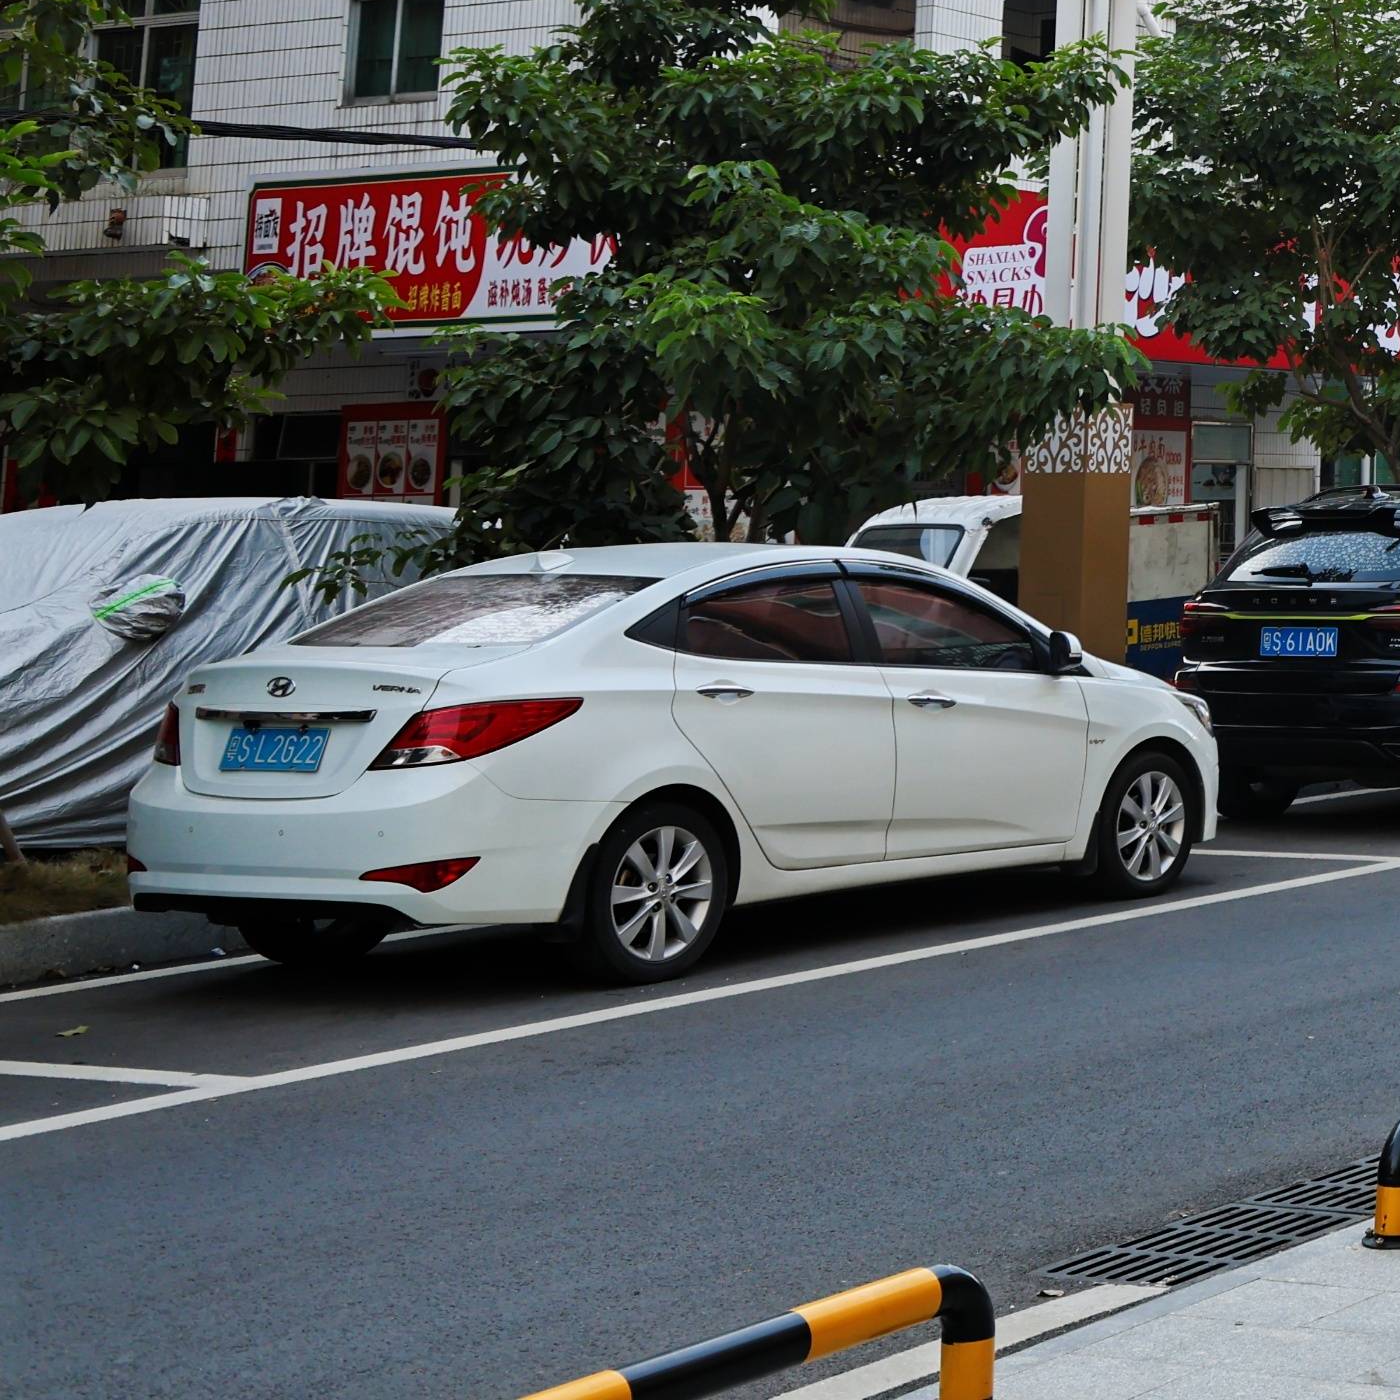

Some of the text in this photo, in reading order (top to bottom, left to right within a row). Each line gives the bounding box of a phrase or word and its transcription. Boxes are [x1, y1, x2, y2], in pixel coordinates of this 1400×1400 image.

[286, 189, 476, 281] 招牌馄饨
[967, 250, 1026, 267] SHAXIAN
[966, 265, 1032, 286] SNACKS
[372, 683, 422, 695] VERNA
